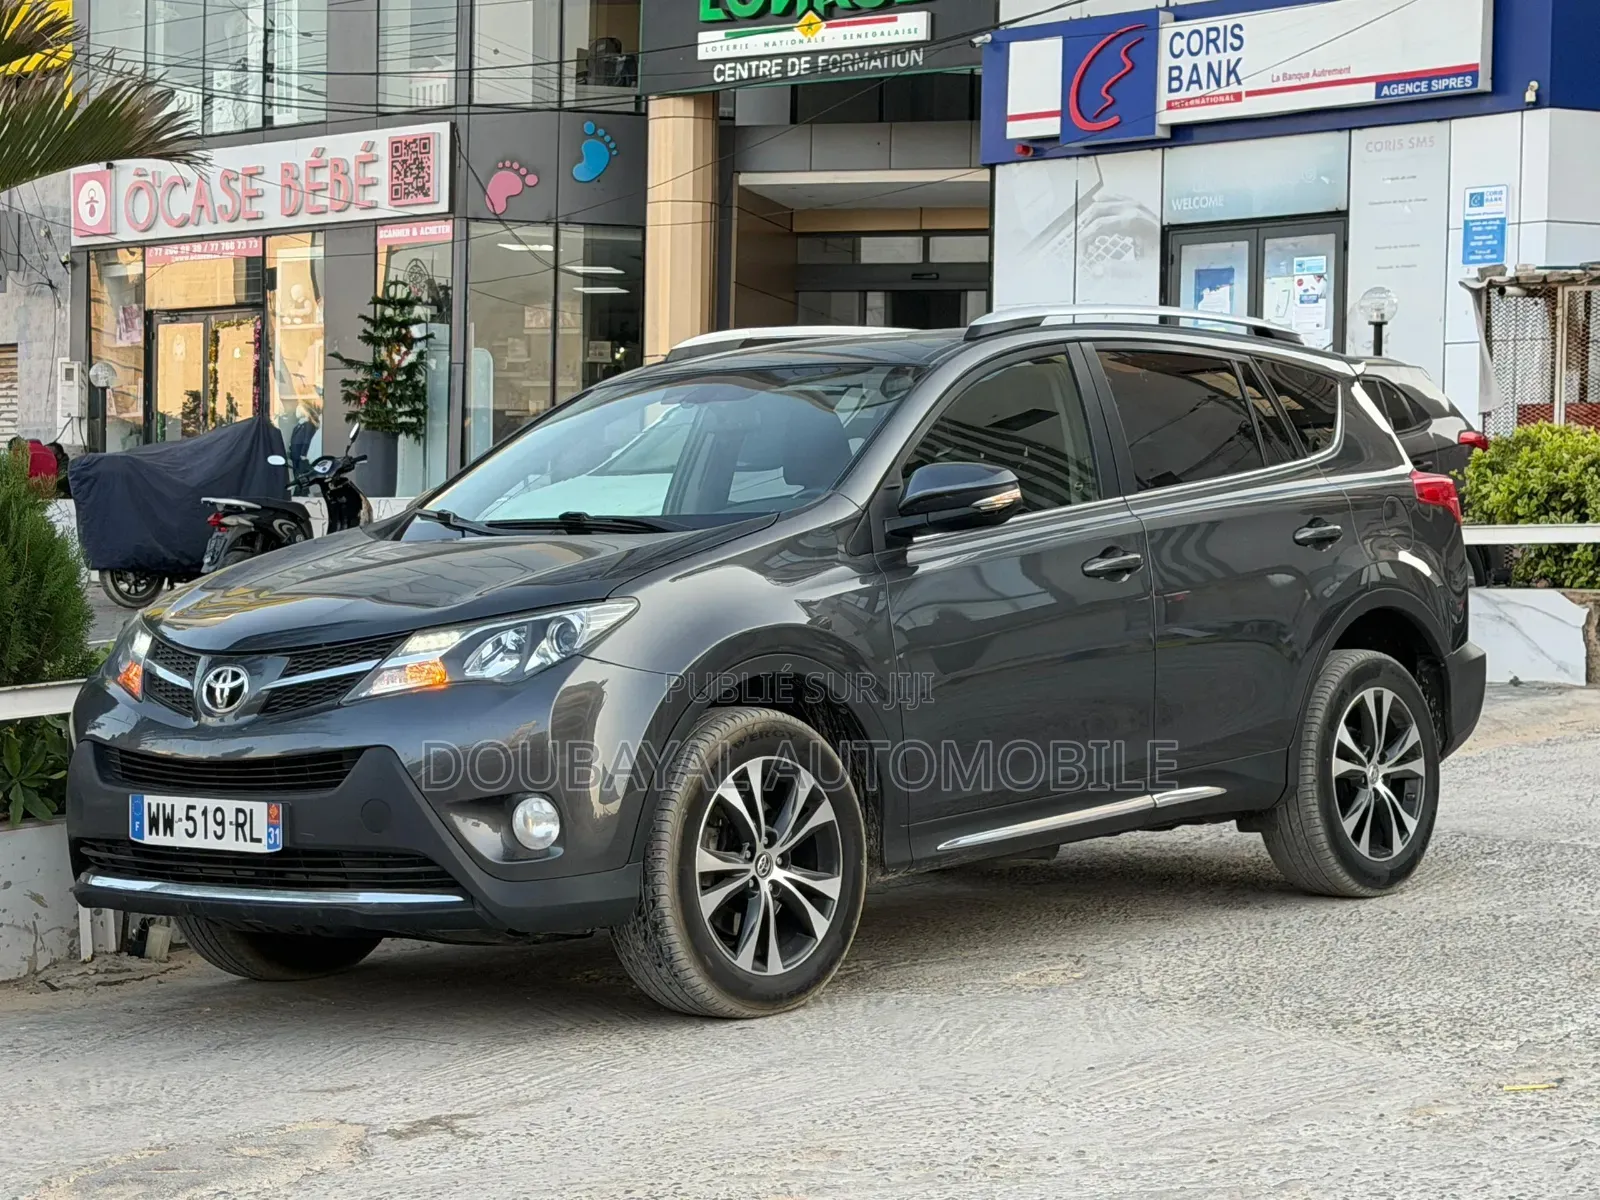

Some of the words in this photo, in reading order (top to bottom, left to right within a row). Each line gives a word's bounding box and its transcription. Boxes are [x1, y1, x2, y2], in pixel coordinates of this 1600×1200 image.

[704, 43, 749, 53] LOTERIE
[763, 36, 826, 48] NATIONALE
[842, 27, 919, 40] SENEGALAISE
[1169, 23, 1245, 59] CORIS
[713, 58, 783, 83] CENTRE
[787, 56, 811, 77] DE
[818, 48, 924, 75] FORMATION
[1167, 57, 1243, 94] BANK
[1271, 74, 1281, 83] La
[1282, 70, 1310, 82] Banque
[1312, 66, 1352, 78] Autrement
[1381, 80, 1429, 97] AGENCE
[1431, 75, 1473, 91] SIPRES
[1365, 139, 1404, 153] CORIS
[1408, 136, 1435, 149] SMS
[280, 140, 379, 217] BÉBÉ
[1172, 195, 1225, 211] WELCOME
[134, 821, 140, 832] F
[268, 827, 279, 845] 31
